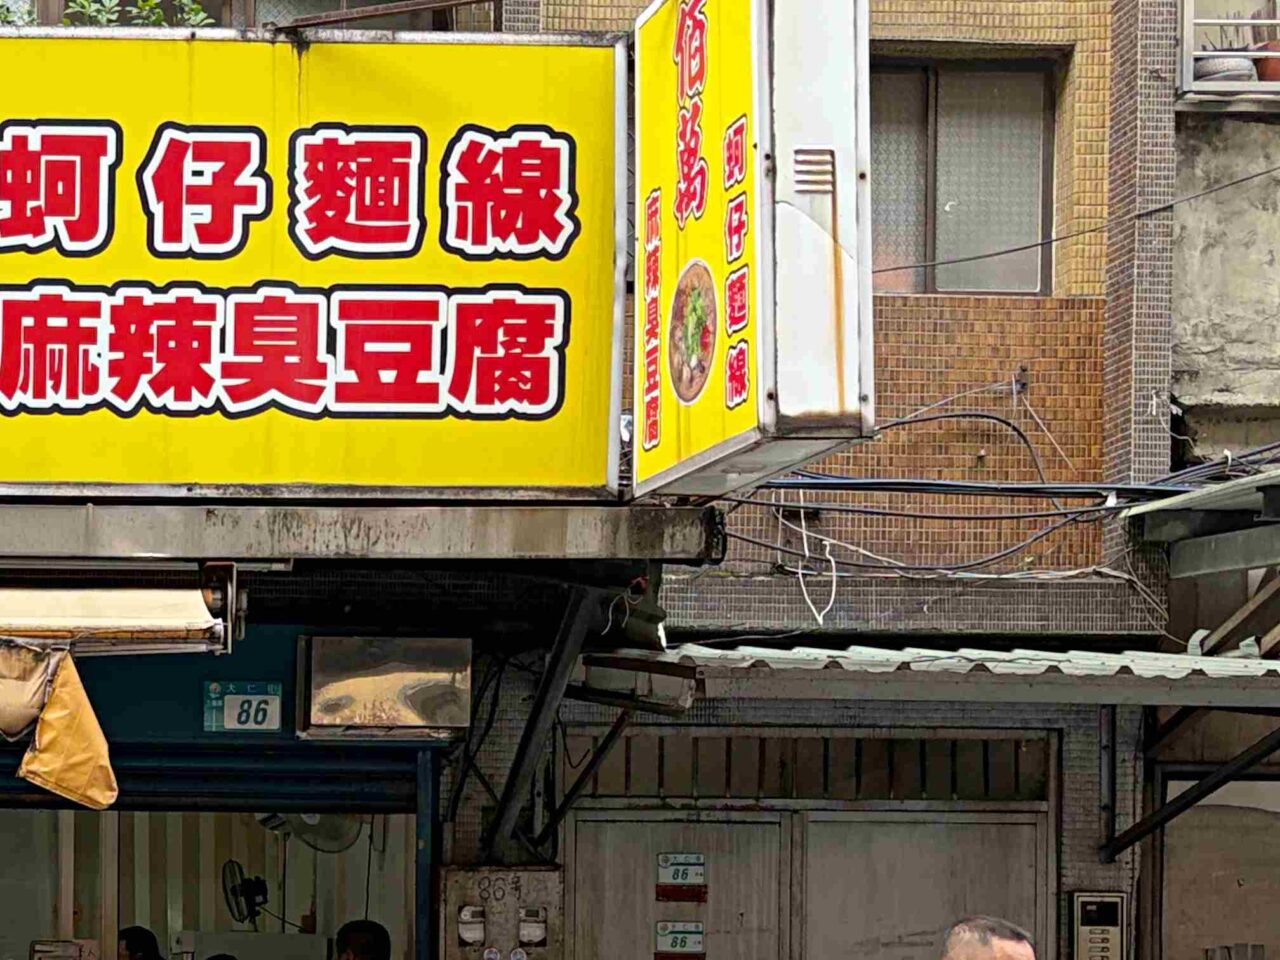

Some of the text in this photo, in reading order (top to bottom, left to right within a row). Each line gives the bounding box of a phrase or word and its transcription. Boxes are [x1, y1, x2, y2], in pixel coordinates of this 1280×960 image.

[673, 0, 708, 229] 佰萬
[642, 187, 661, 452] 麻辣臭豆腐
[724, 114, 750, 410] 蚵仔麵線
[237, 699, 269, 725] 86
[672, 868, 688, 880] 86
[671, 936, 687, 948] 86
